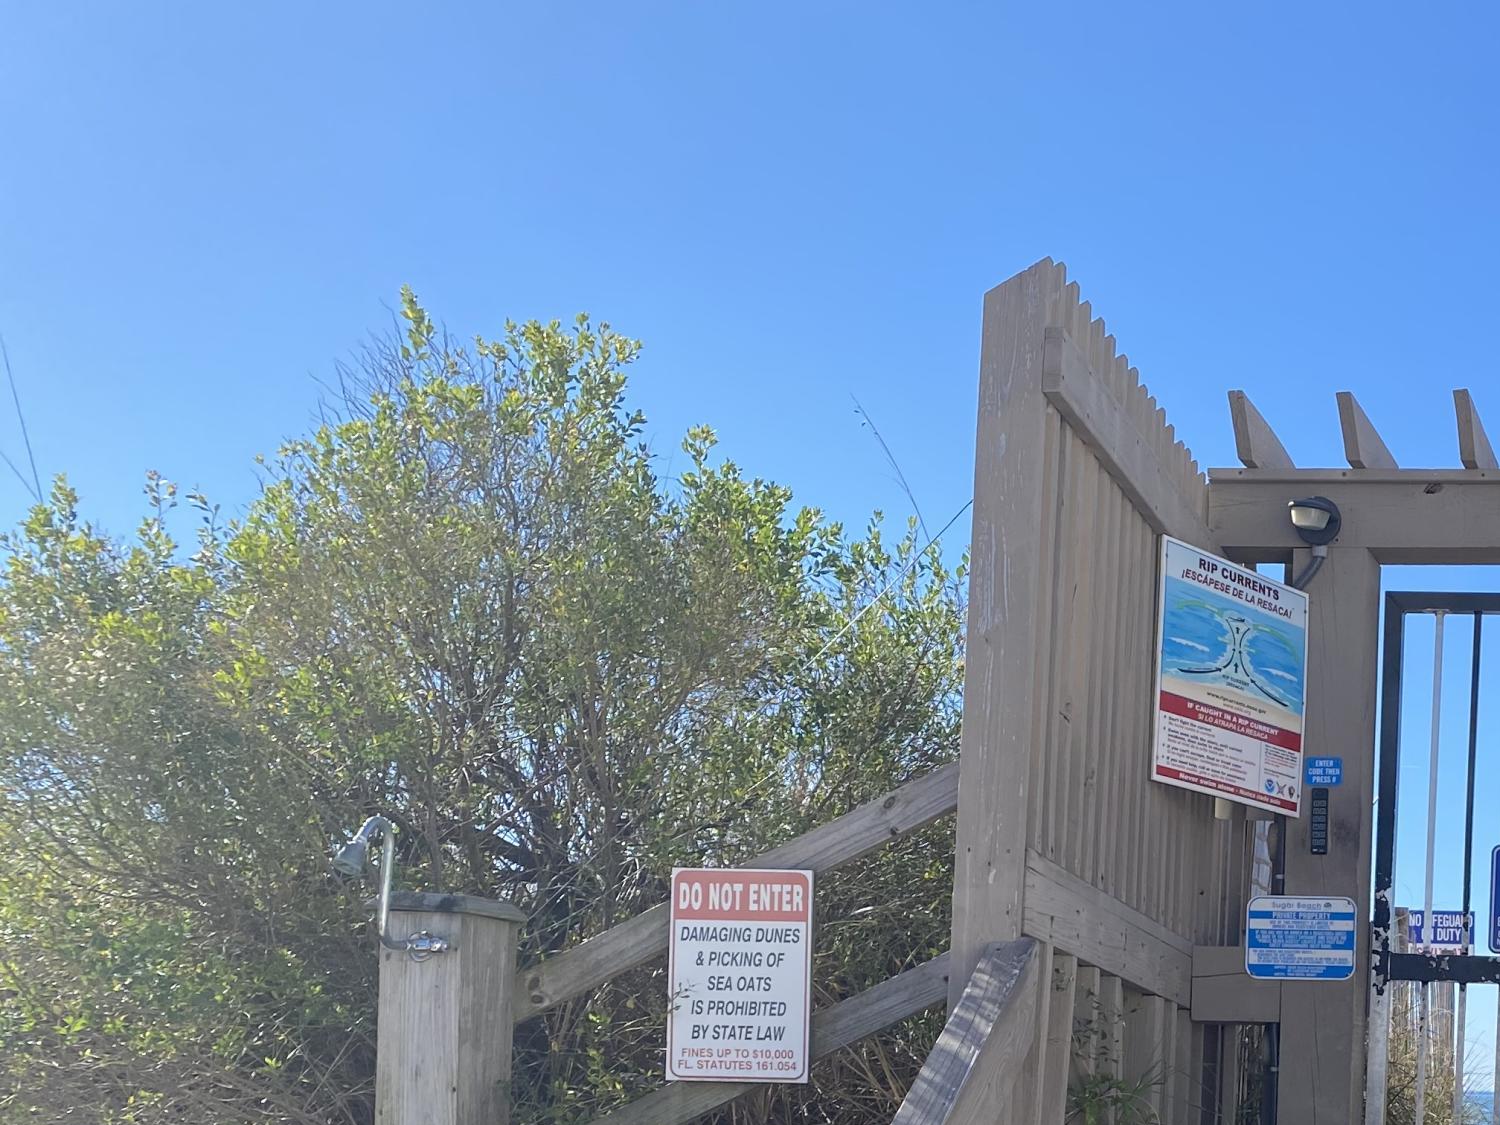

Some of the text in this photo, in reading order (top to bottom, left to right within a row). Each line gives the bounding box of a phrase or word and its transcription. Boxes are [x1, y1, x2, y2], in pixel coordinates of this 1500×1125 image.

[1199, 558, 1279, 600] RIP CURRENTS
[1232, 587, 1243, 599] DE
[1245, 593, 1255, 604] LA
[1257, 598, 1292, 619] RESACA!
[1195, 704, 1222, 718] CAUGHT
[1224, 712, 1232, 721] IN
[1232, 714, 1238, 722] A
[1238, 717, 1250, 726] RIP
[1250, 720, 1279, 736] CURRENT
[1237, 723, 1245, 732] LA
[1245, 726, 1268, 740] RESACA
[679, 882, 803, 912] DO NOT ENTER
[1409, 913, 1422, 926] NO
[681, 926, 800, 943] DAMAGING DUNES
[1437, 928, 1461, 940] DUTY
[696, 951, 785, 968] & PICKING OF
[707, 976, 772, 991] SEA OATS
[691, 1000, 786, 1017] IS PROHIBITED
[692, 1024, 785, 1041] BY STATE LAW
[681, 1048, 794, 1061] FINES UP TO $10,000
[678, 1060, 797, 1071] FL. STATUTES 161.054
